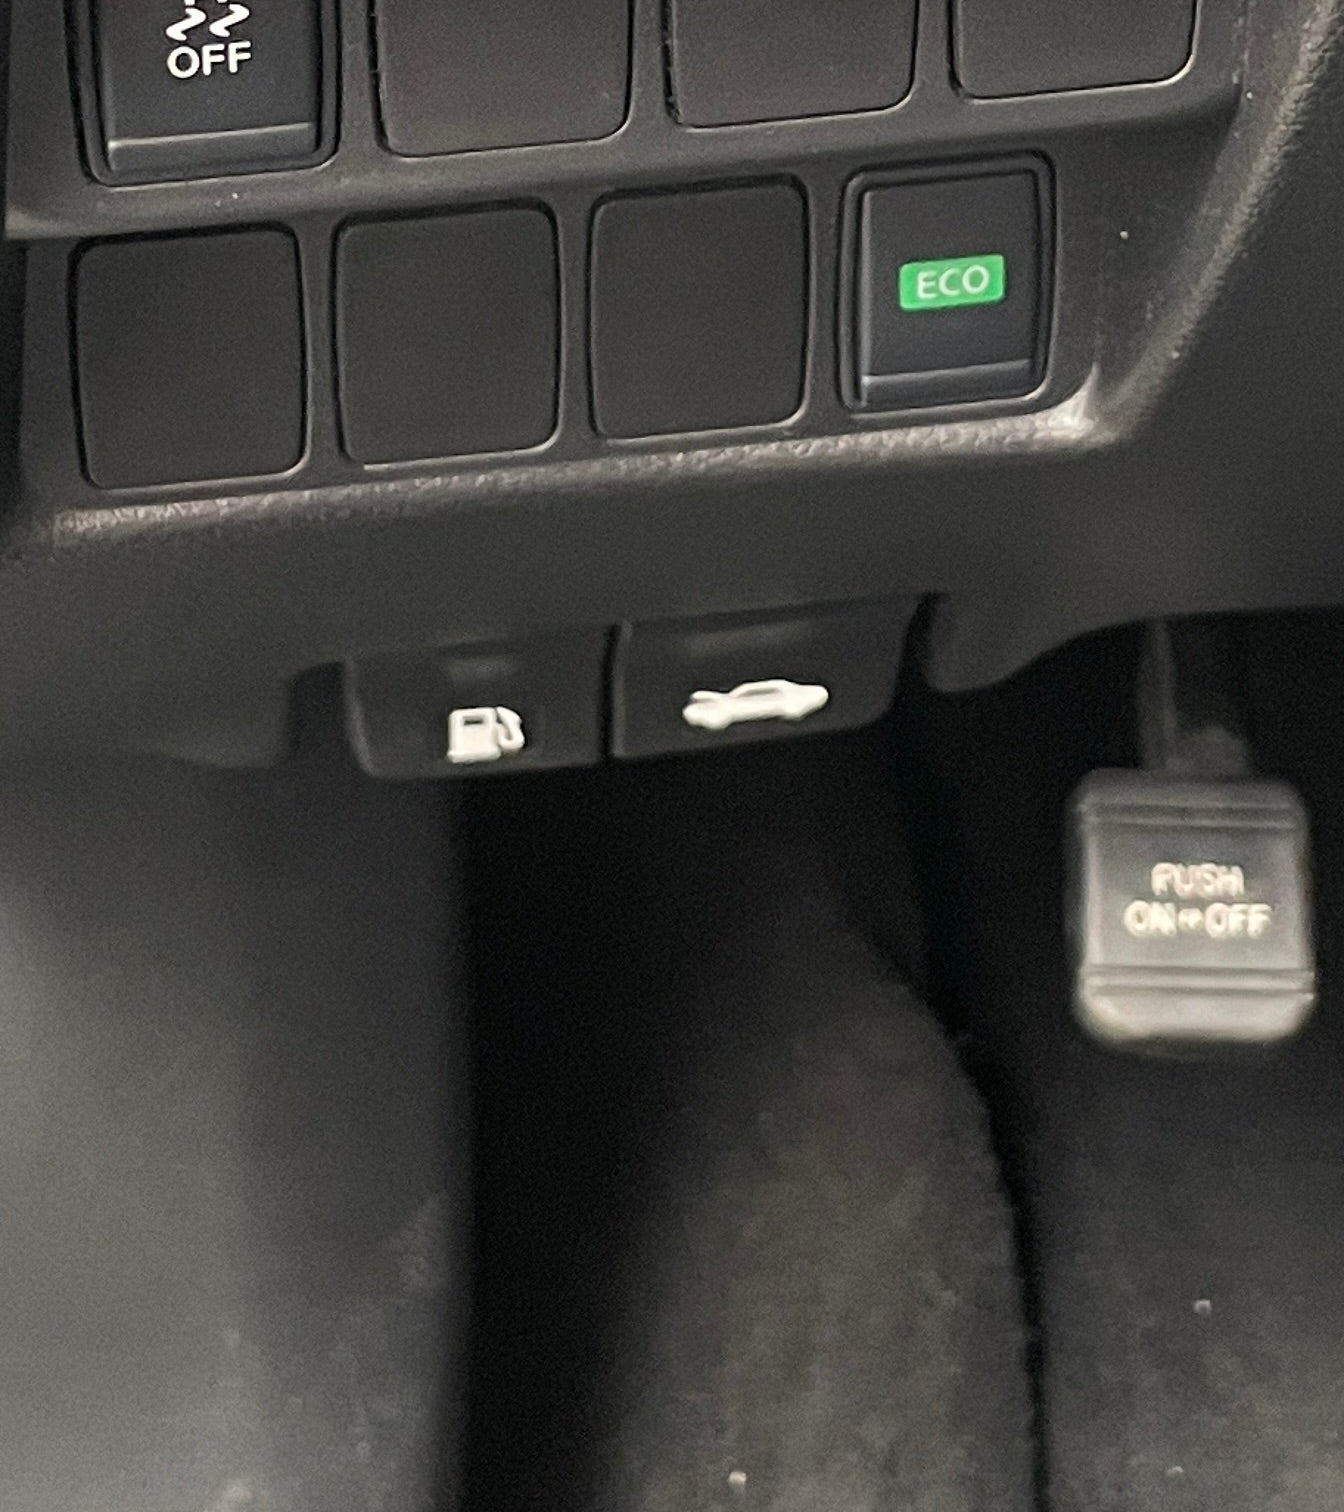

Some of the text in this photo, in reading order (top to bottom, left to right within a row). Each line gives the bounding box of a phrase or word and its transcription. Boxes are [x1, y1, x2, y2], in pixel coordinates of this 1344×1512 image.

[166, 40, 252, 79] OFF
[916, 264, 990, 300] ECO
[1150, 861, 1245, 900] PUSH
[1204, 901, 1273, 939] OFF
